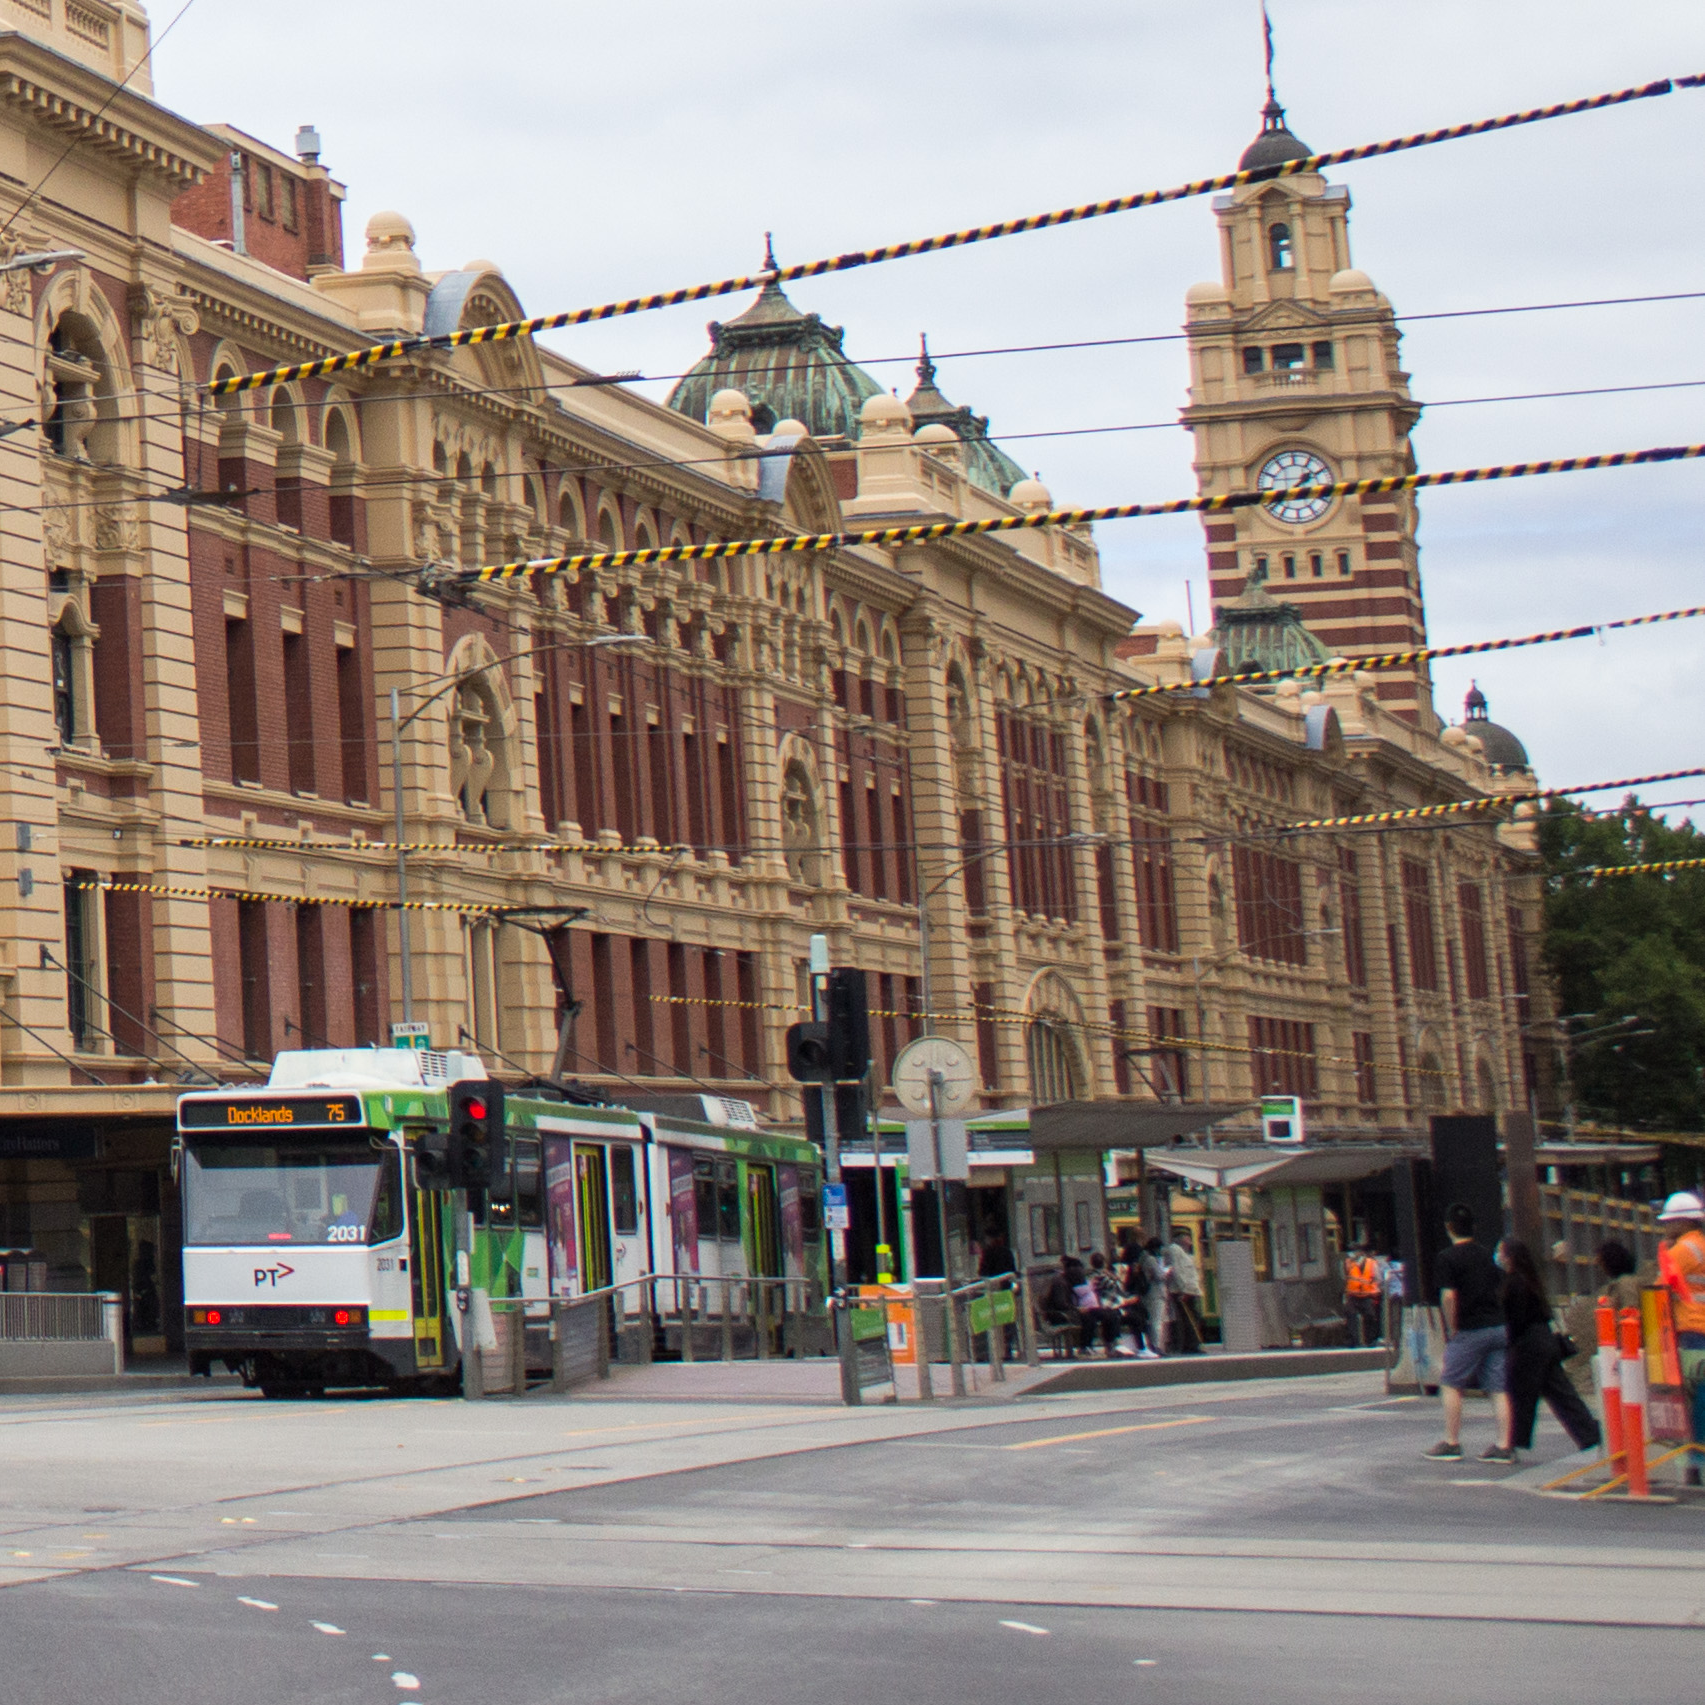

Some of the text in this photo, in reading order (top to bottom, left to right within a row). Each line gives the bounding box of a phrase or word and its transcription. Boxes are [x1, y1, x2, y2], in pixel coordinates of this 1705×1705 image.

[228, 1104, 344, 1124] Docklands 75
[327, 1225, 366, 1242] 2031
[377, 1258, 394, 1272] 2031
